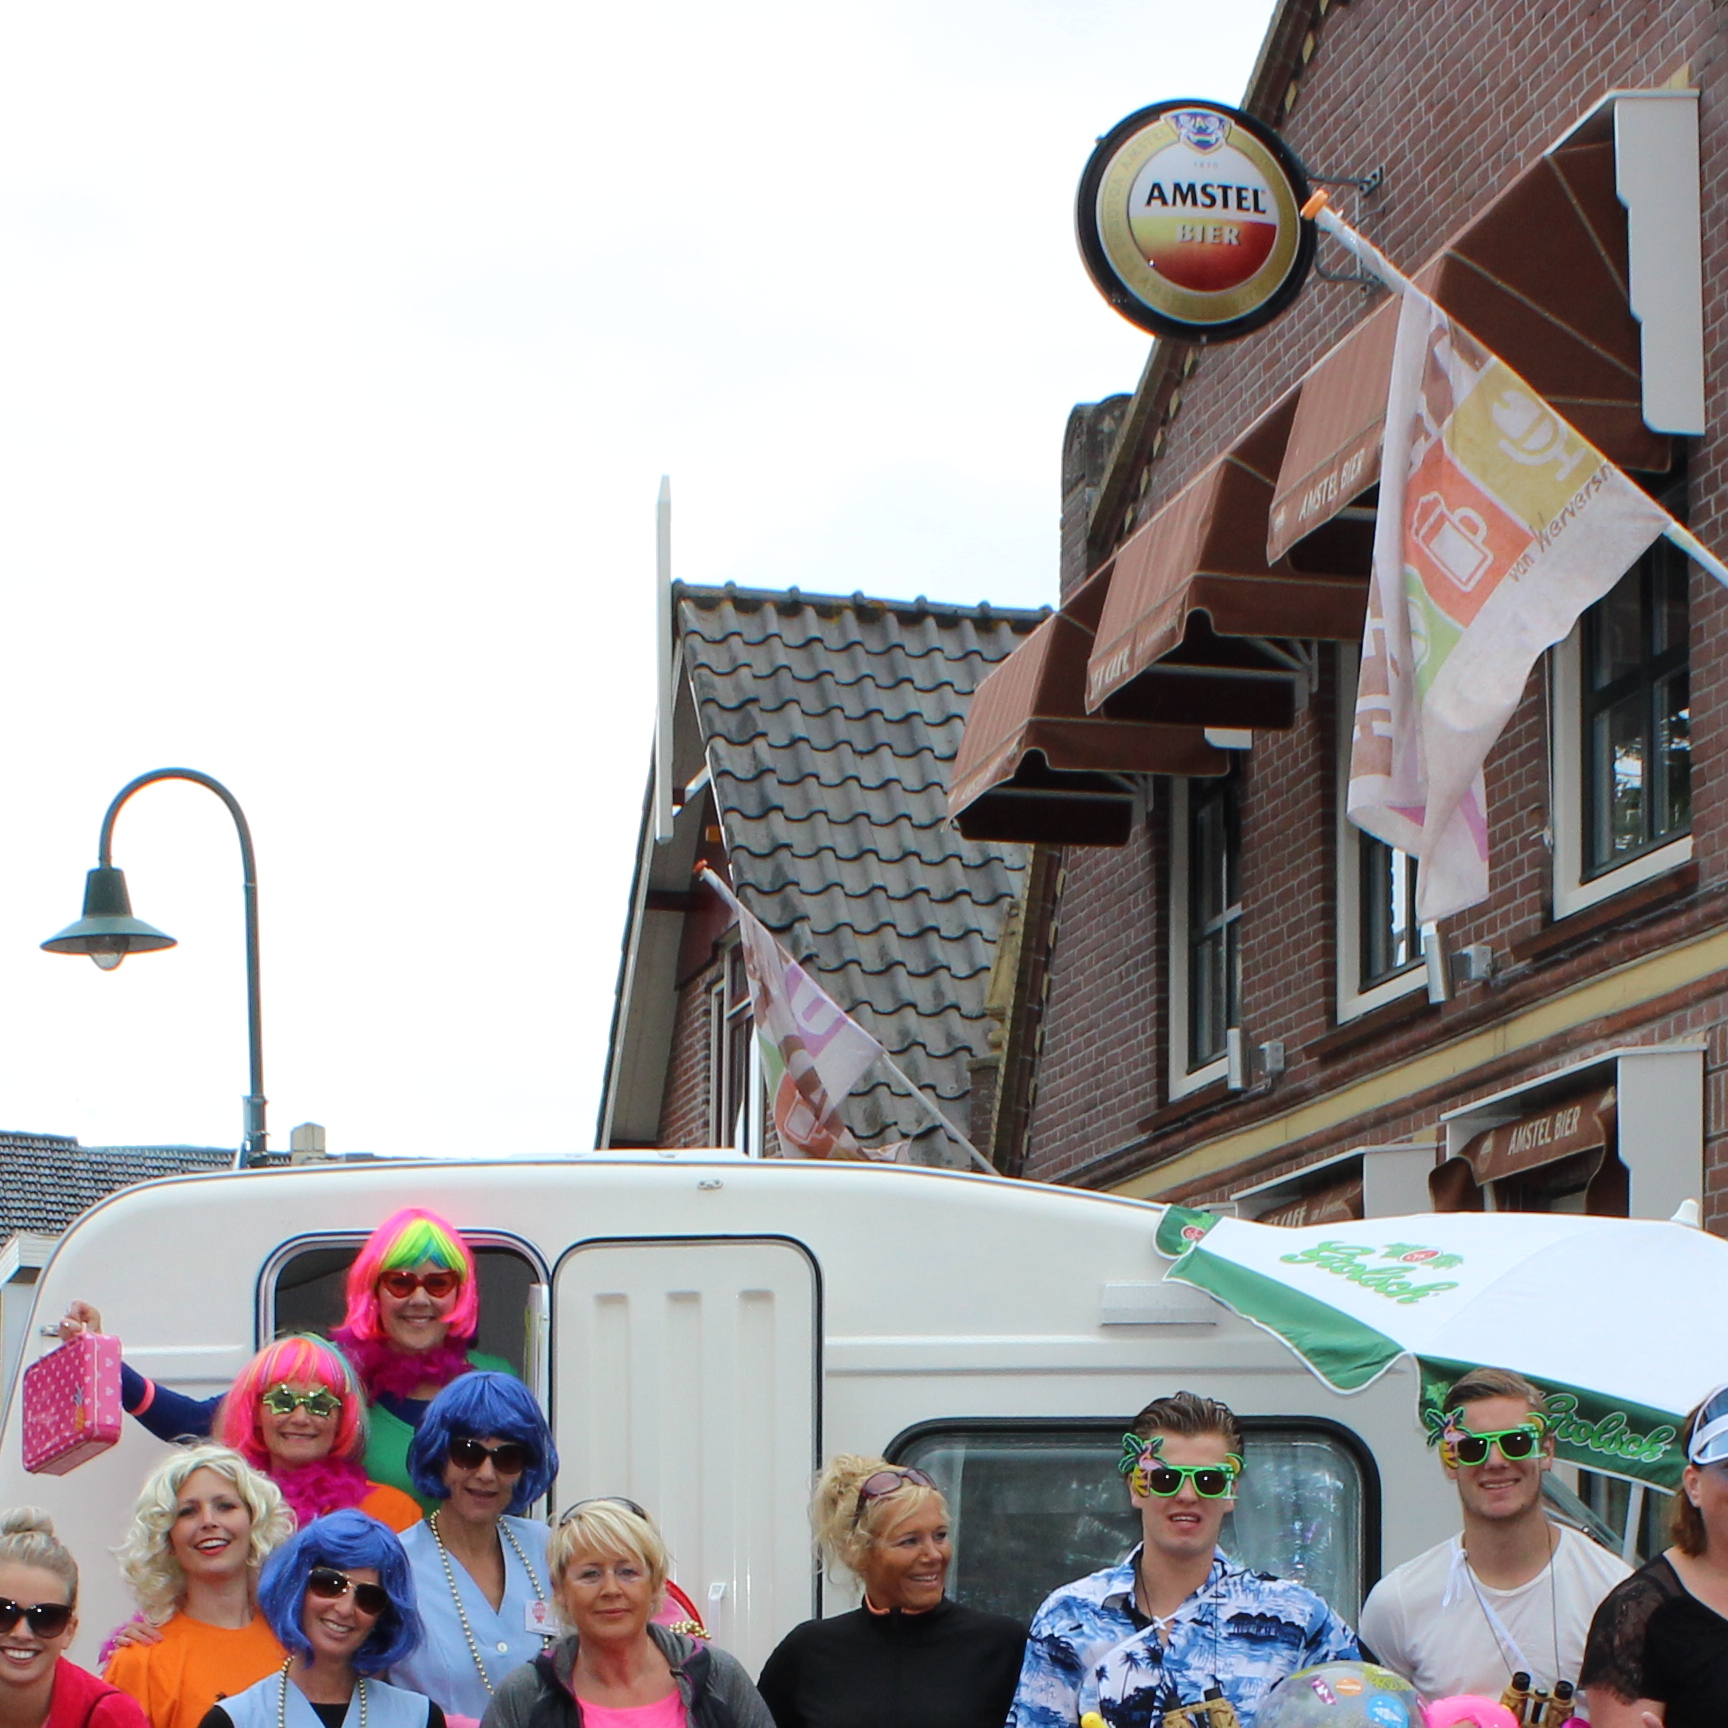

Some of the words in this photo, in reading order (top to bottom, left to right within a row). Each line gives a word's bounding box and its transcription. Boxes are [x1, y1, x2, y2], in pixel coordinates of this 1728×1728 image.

[1145, 181, 1267, 215] AMSTEL
[1176, 223, 1241, 246] BIER
[1298, 470, 1338, 523] AMSTEL
[1339, 447, 1366, 490] BIER
[1509, 552, 1535, 583] van
[1507, 1114, 1552, 1156] AMSTEL
[1553, 1104, 1582, 1139] BIER
